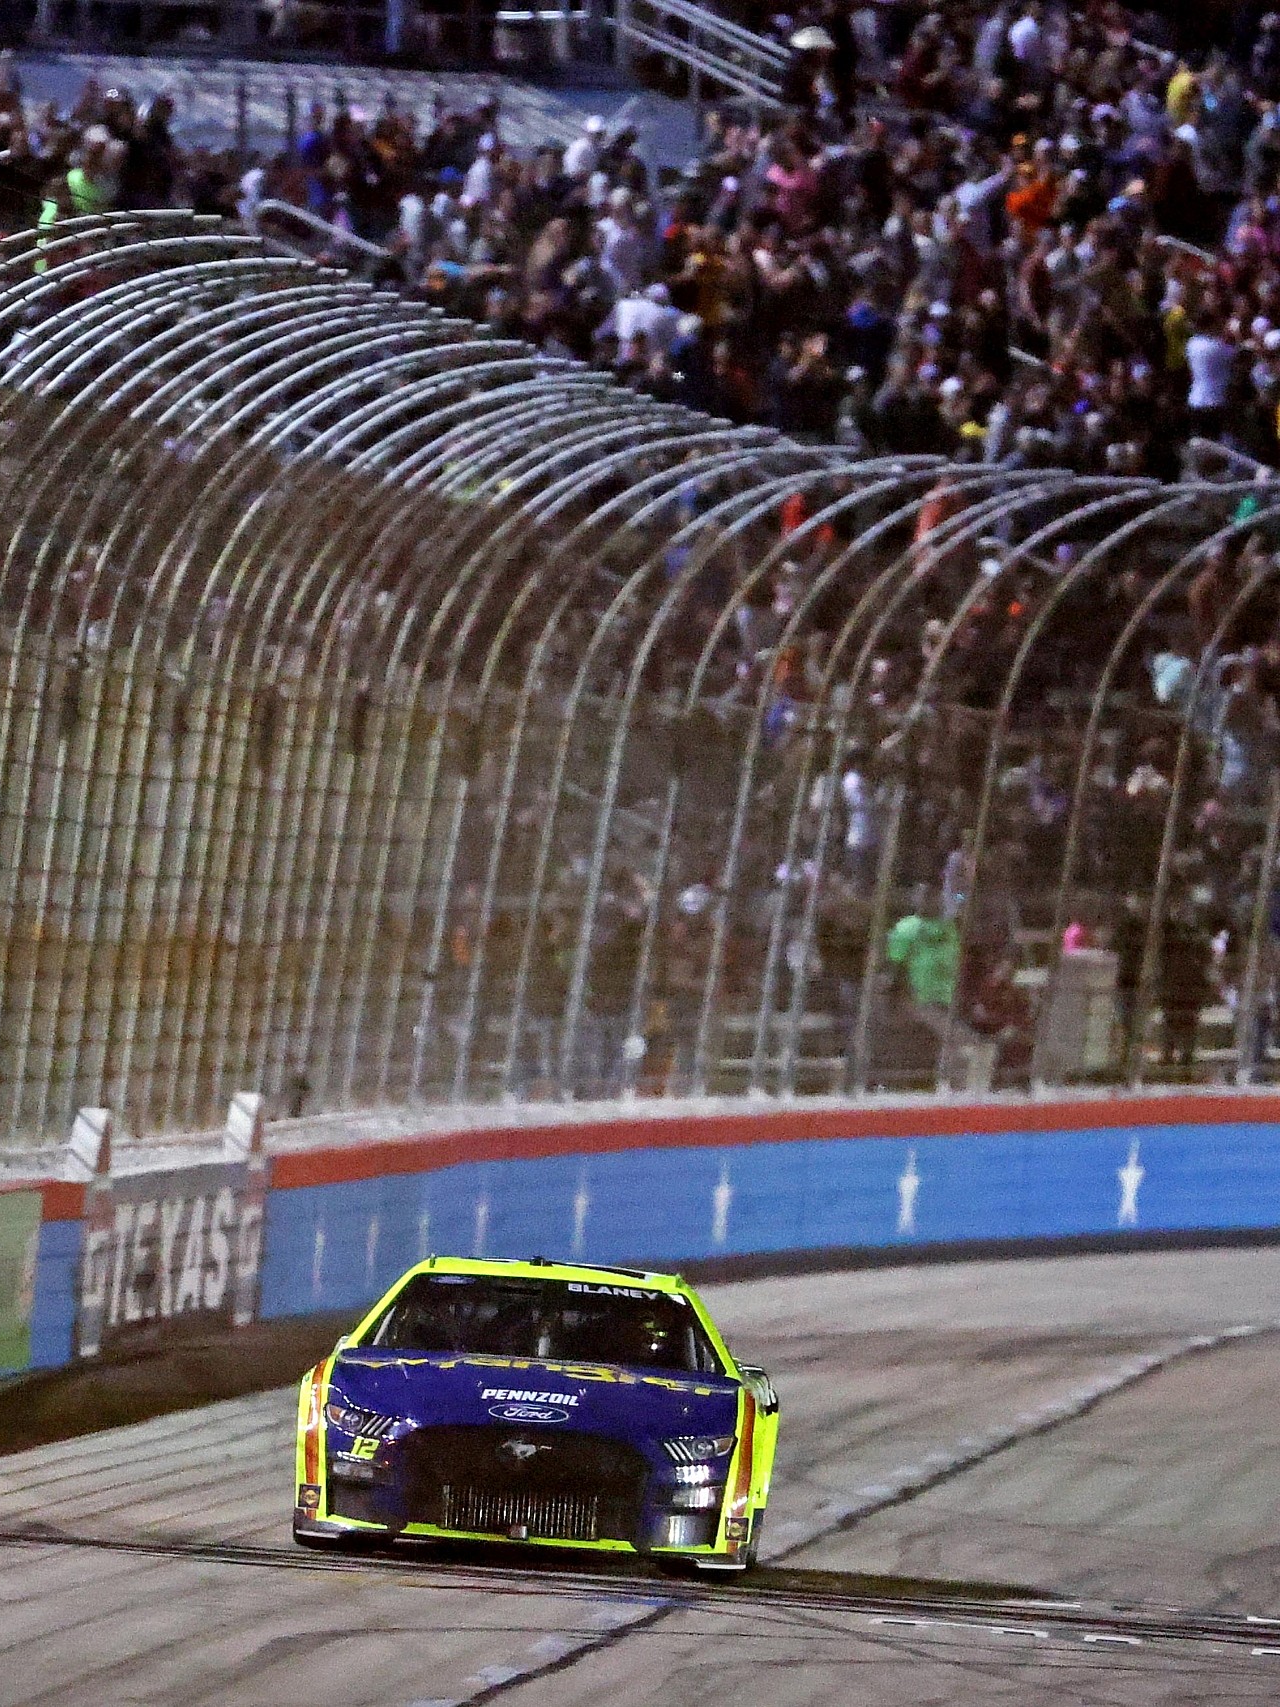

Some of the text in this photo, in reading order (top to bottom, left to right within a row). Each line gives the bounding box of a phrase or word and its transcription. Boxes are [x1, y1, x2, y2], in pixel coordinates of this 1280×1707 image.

[108, 1187, 234, 1326] TEXAS
[567, 1282, 659, 1301] BLANEY
[481, 1388, 580, 1407] PENNZOIL
[350, 1435, 381, 1461] 12
